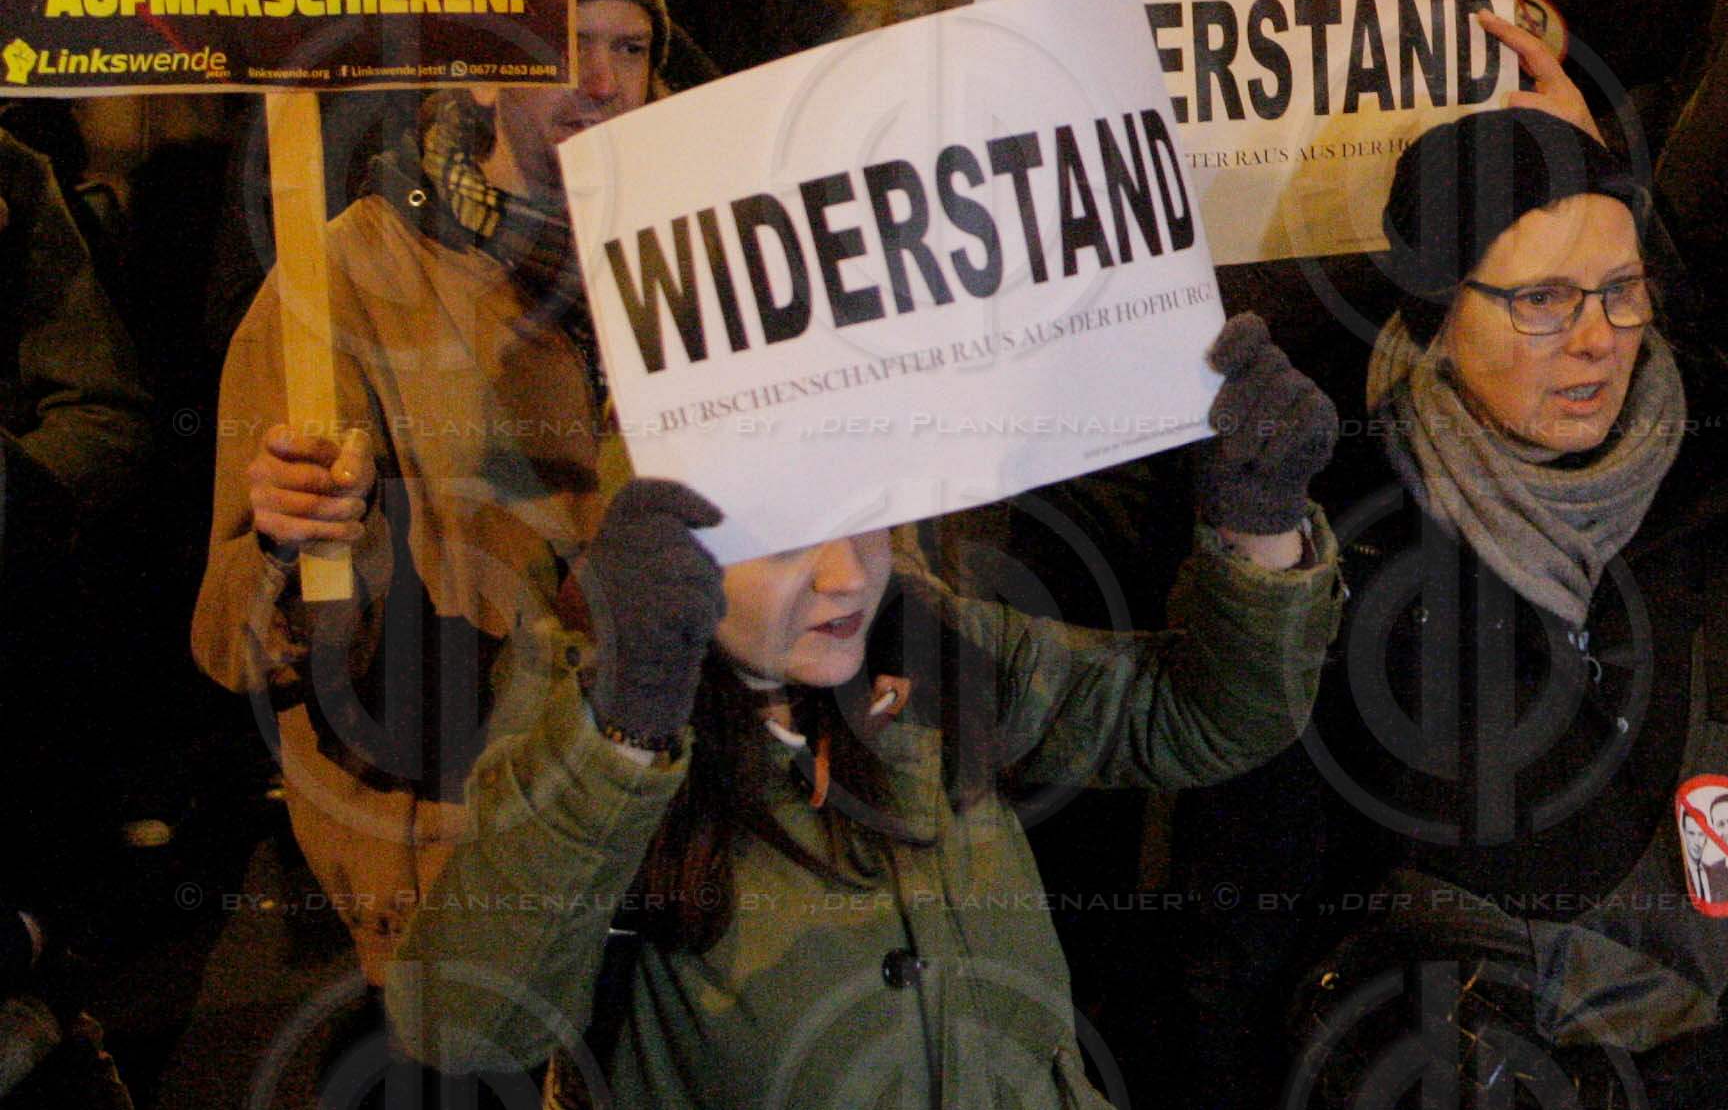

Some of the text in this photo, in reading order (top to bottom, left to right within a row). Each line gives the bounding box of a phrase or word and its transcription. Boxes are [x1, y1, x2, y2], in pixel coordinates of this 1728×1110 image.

[38, 46, 228, 74] Linkswende
[1234, 147, 1290, 166] RAUS
[1296, 144, 1337, 163] AUS
[1342, 141, 1384, 160] DER
[603, 107, 1196, 376] WIDERSTAND
[659, 281, 1213, 432] BURSCHENSCHAFTER RAUS AUS DER HOFBURG!
